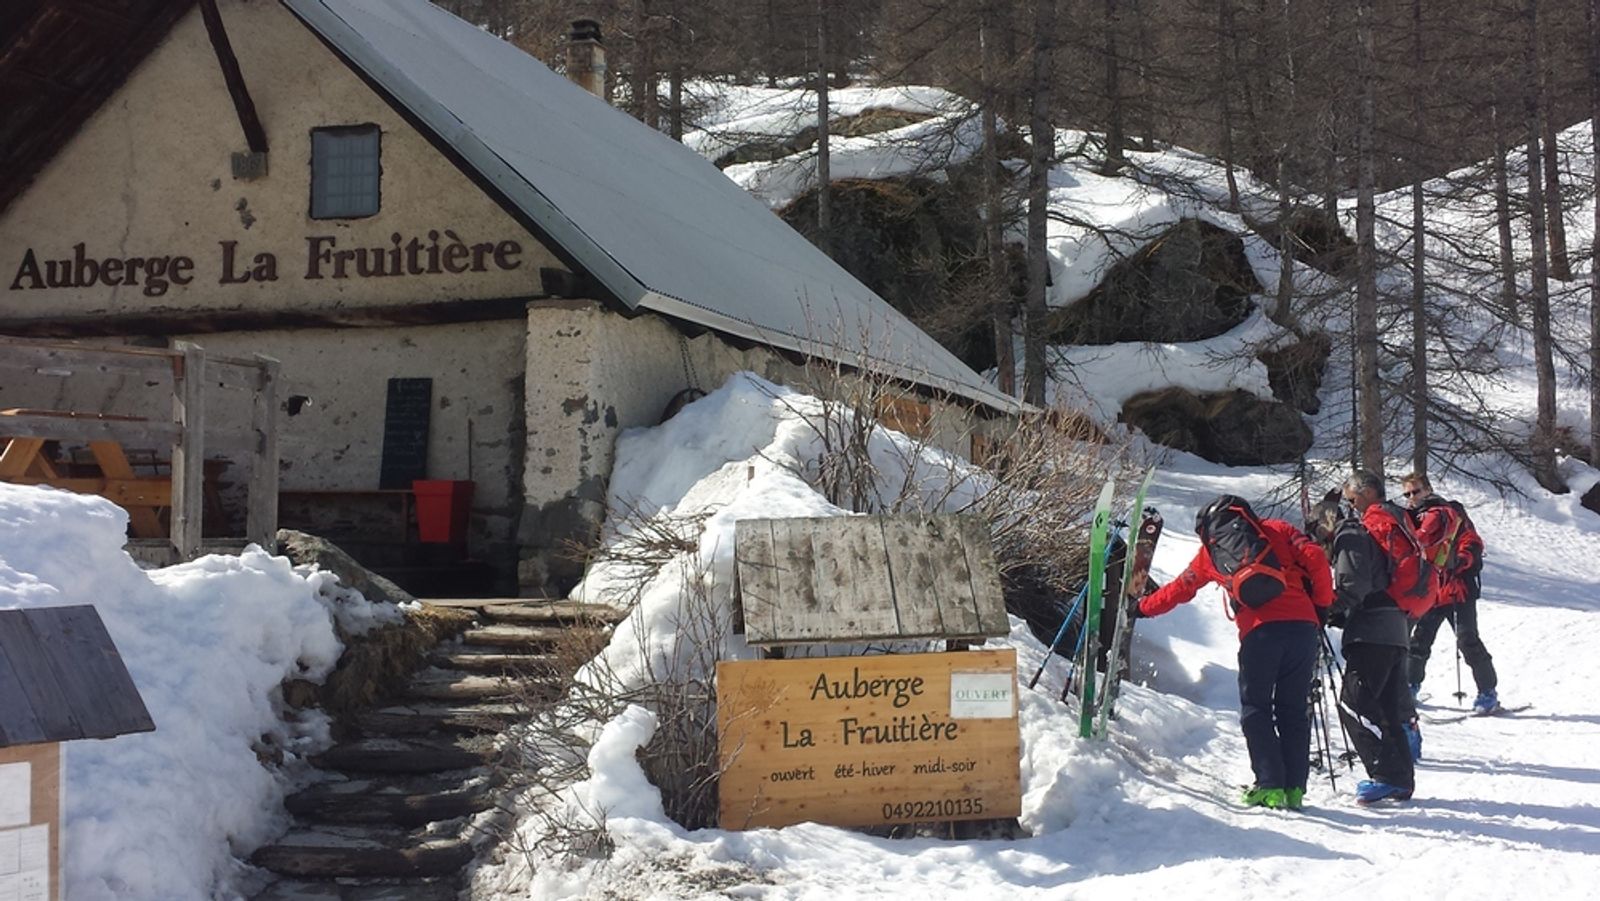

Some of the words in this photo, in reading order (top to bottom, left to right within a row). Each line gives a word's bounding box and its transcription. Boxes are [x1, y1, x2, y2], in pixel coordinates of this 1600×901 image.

[9, 242, 194, 296] Auberge
[218, 240, 279, 284] La
[304, 228, 523, 280] Fruitière
[810, 667, 925, 708] Auberge
[955, 688, 1009, 699] OUVERT
[780, 721, 816, 749] La
[840, 714, 959, 746] Fruitière
[770, 767, 816, 783] ouvert
[834, 761, 897, 779] été-hiver
[913, 757, 978, 775] midi-soir
[882, 798, 984, 820] 0492210135
